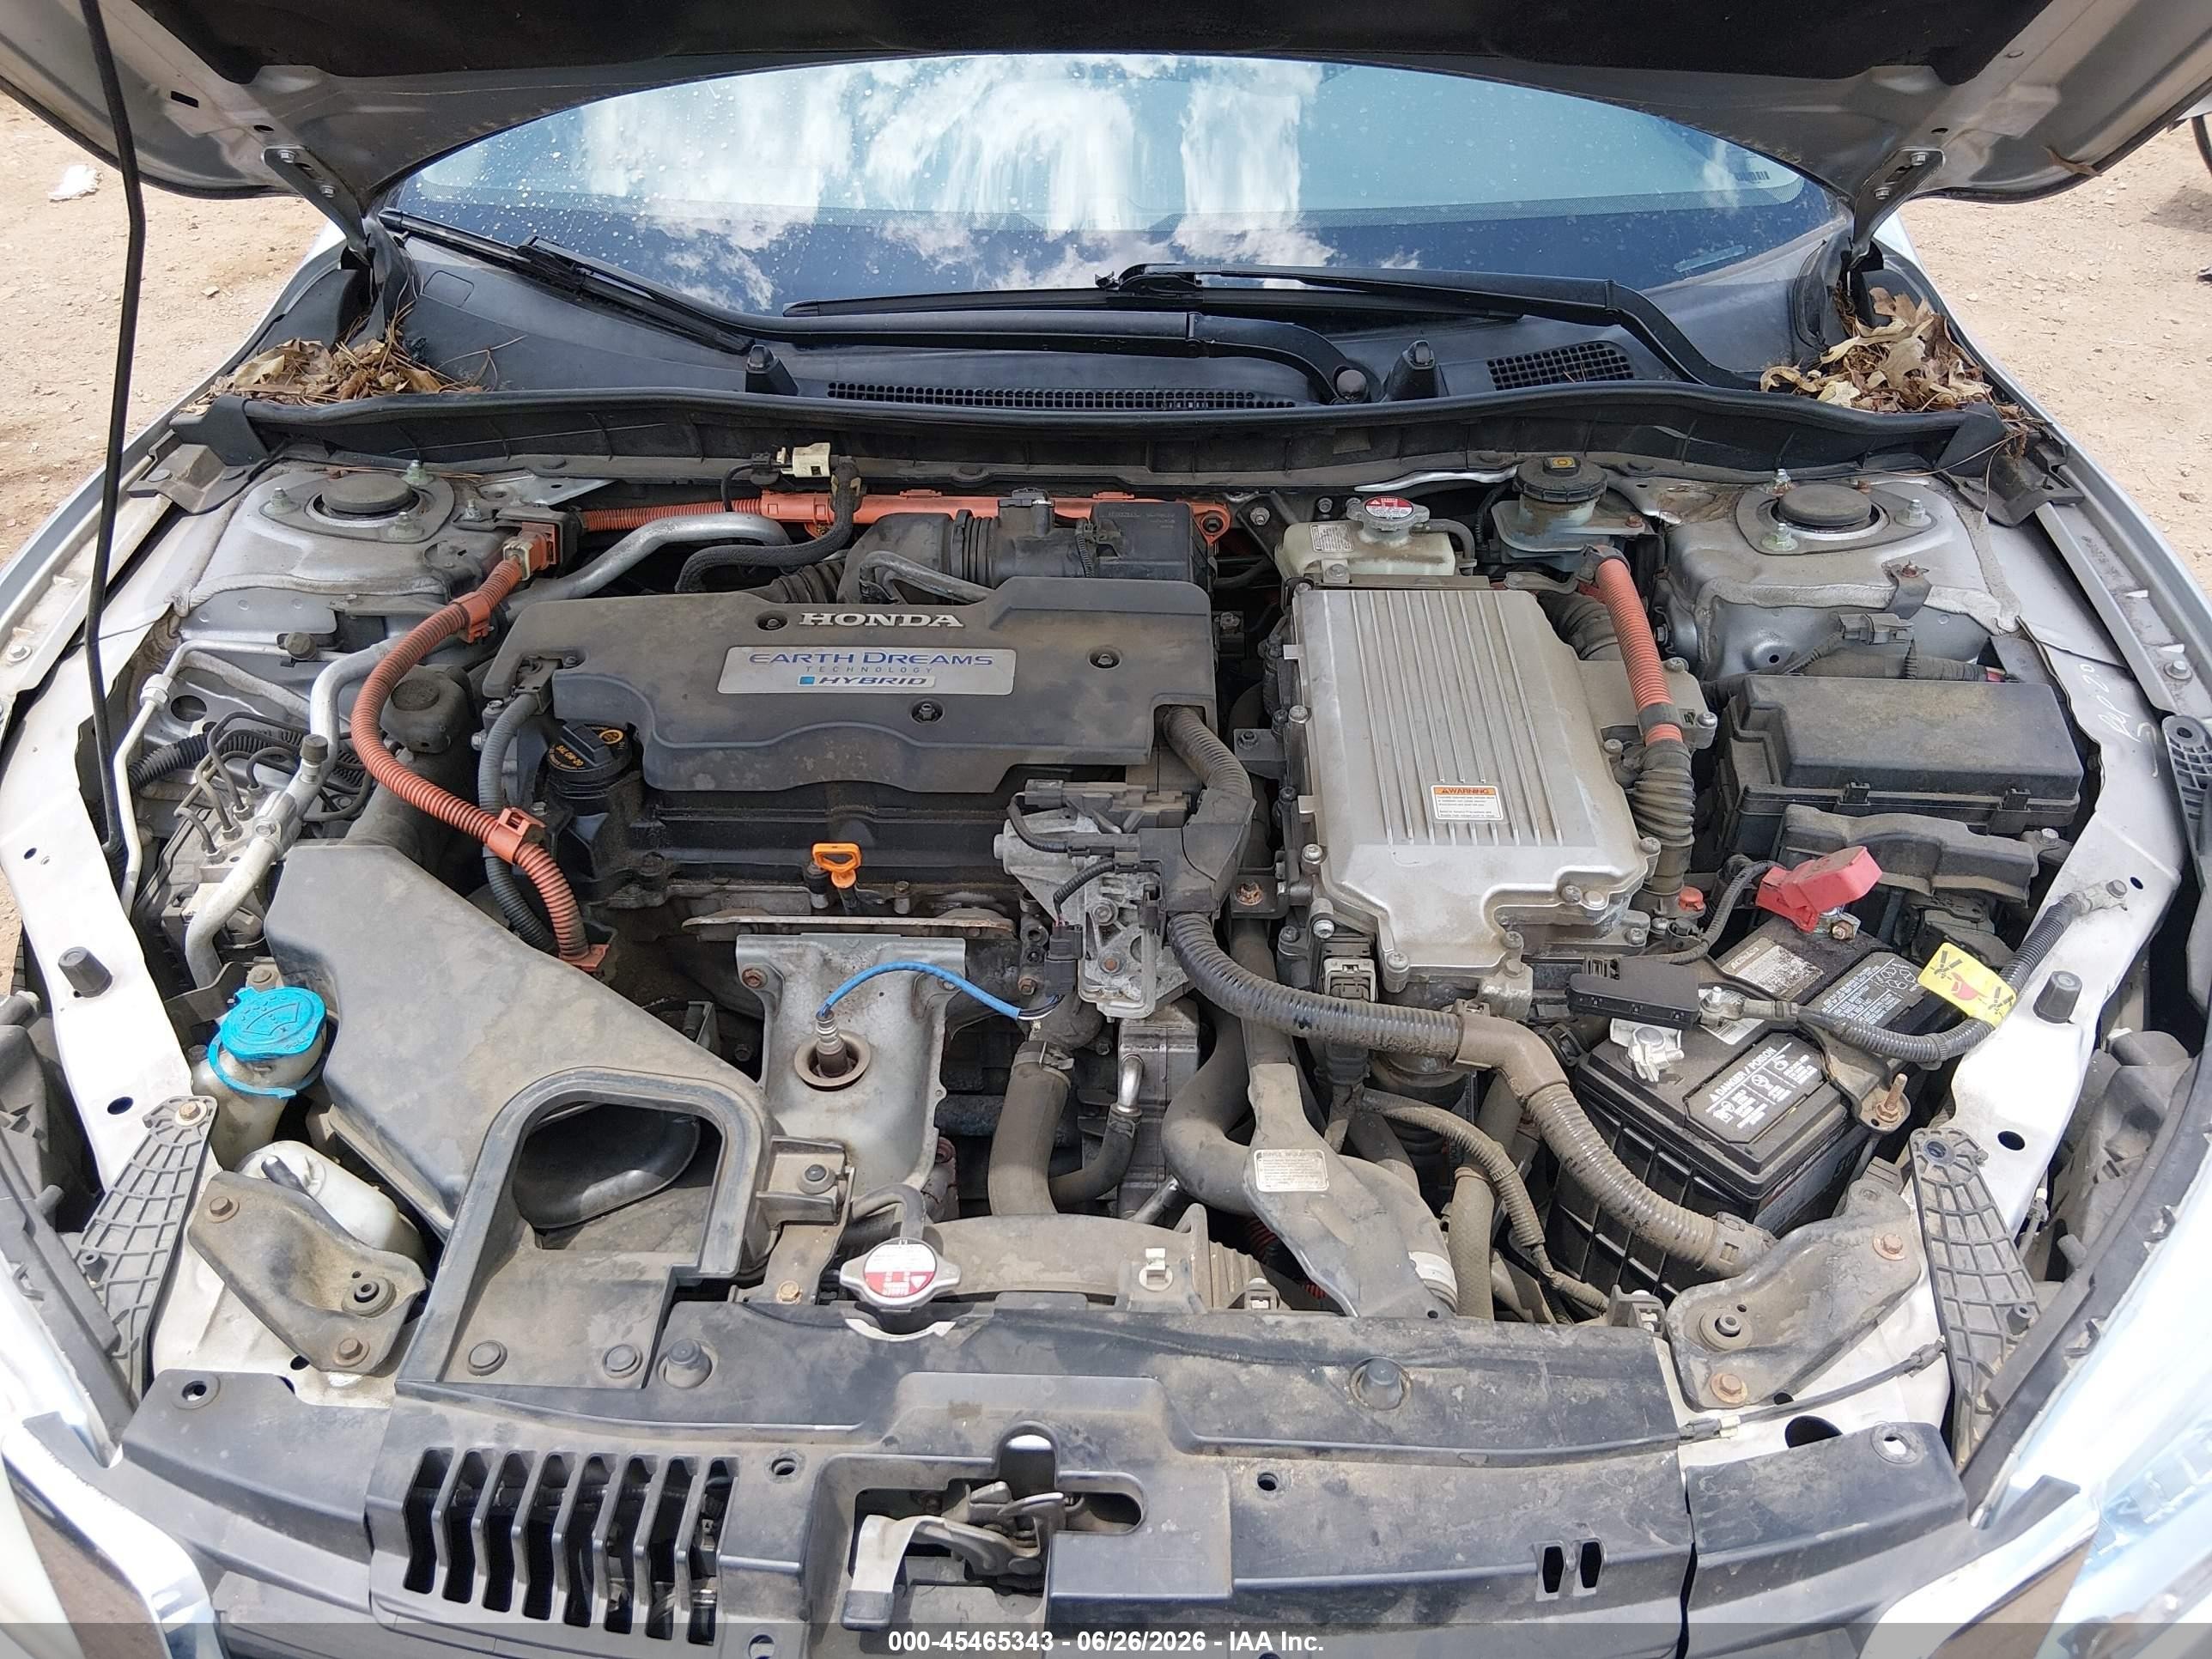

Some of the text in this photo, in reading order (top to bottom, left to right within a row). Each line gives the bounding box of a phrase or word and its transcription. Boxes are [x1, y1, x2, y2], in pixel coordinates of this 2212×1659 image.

[799, 612, 963, 628] HONDA
[749, 652, 994, 665] EARTH DREAMS
[805, 665, 933, 674] TECHNOLOGY
[818, 676, 927, 685] HYBRID
[1715, 1070, 1746, 1097] DANGER
[1751, 1046, 1778, 1071] POISON
